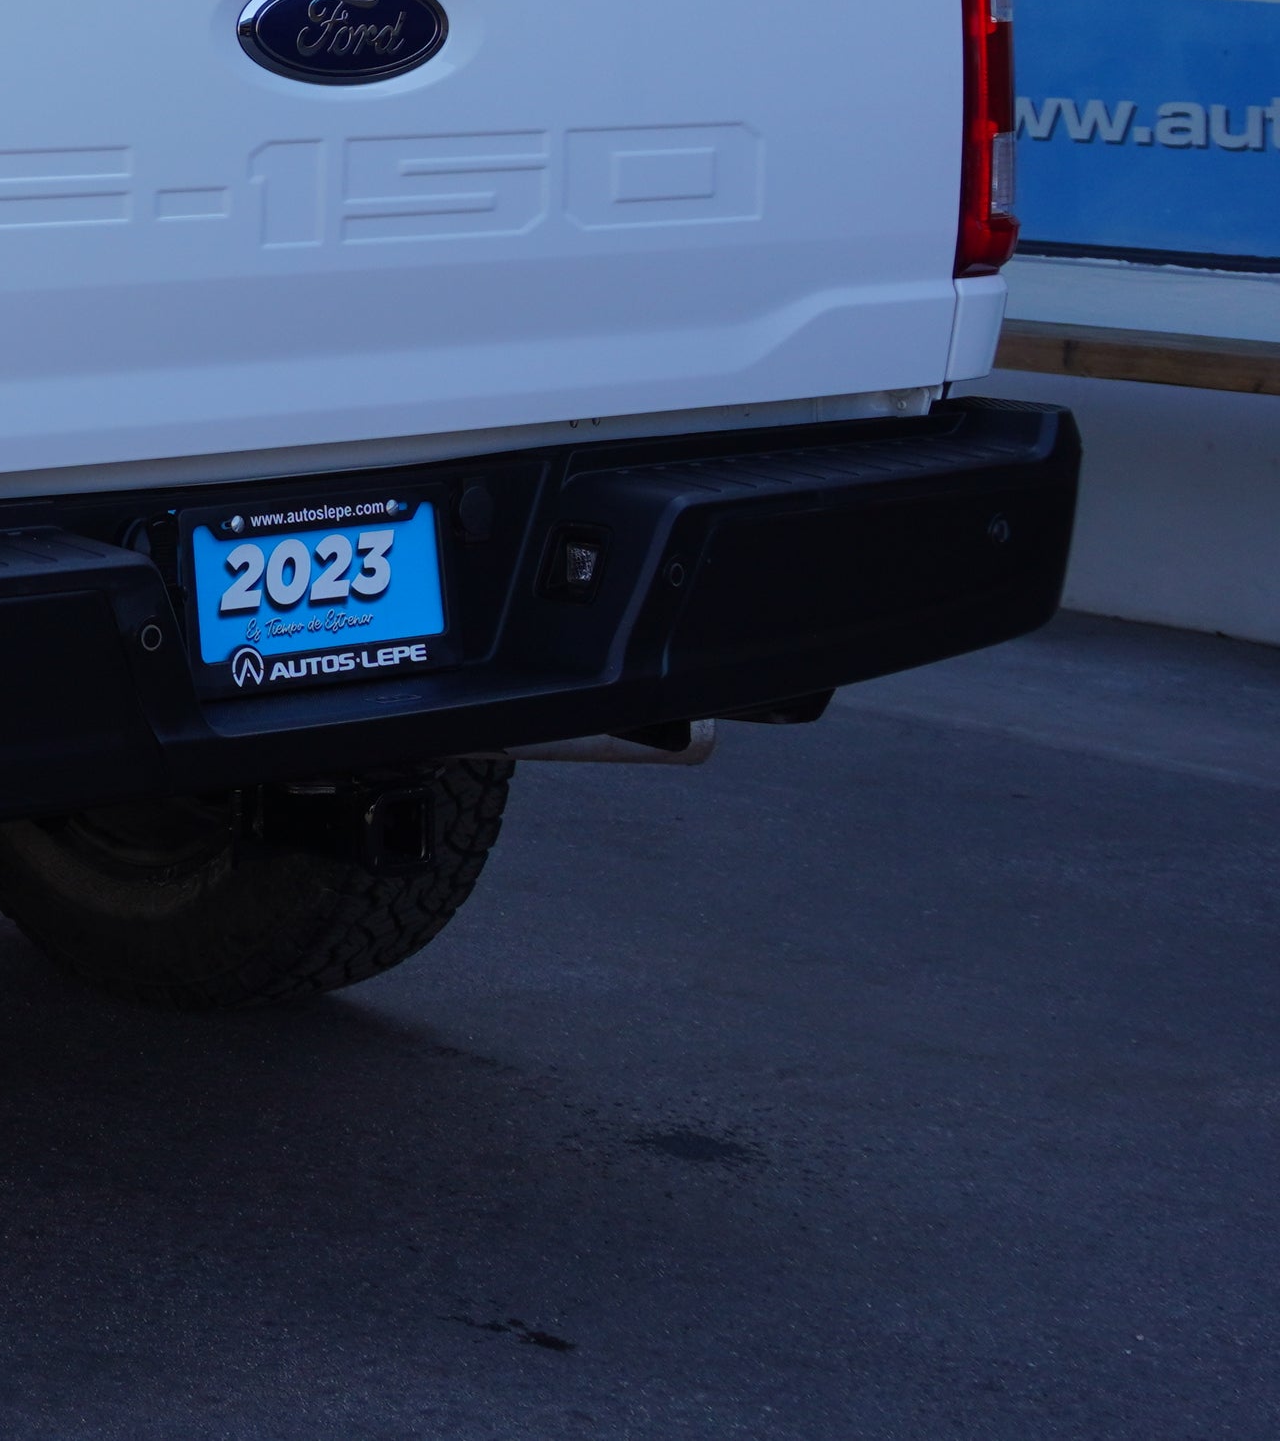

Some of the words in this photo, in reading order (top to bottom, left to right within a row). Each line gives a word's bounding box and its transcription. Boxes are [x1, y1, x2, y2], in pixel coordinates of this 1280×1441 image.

[250, 500, 384, 528] www.autoslepe.com
[220, 529, 395, 612] 2023
[246, 617, 261, 641] Es
[265, 616, 305, 638] Tiempo
[307, 615, 323, 632] de
[325, 608, 374, 632] Estrenar
